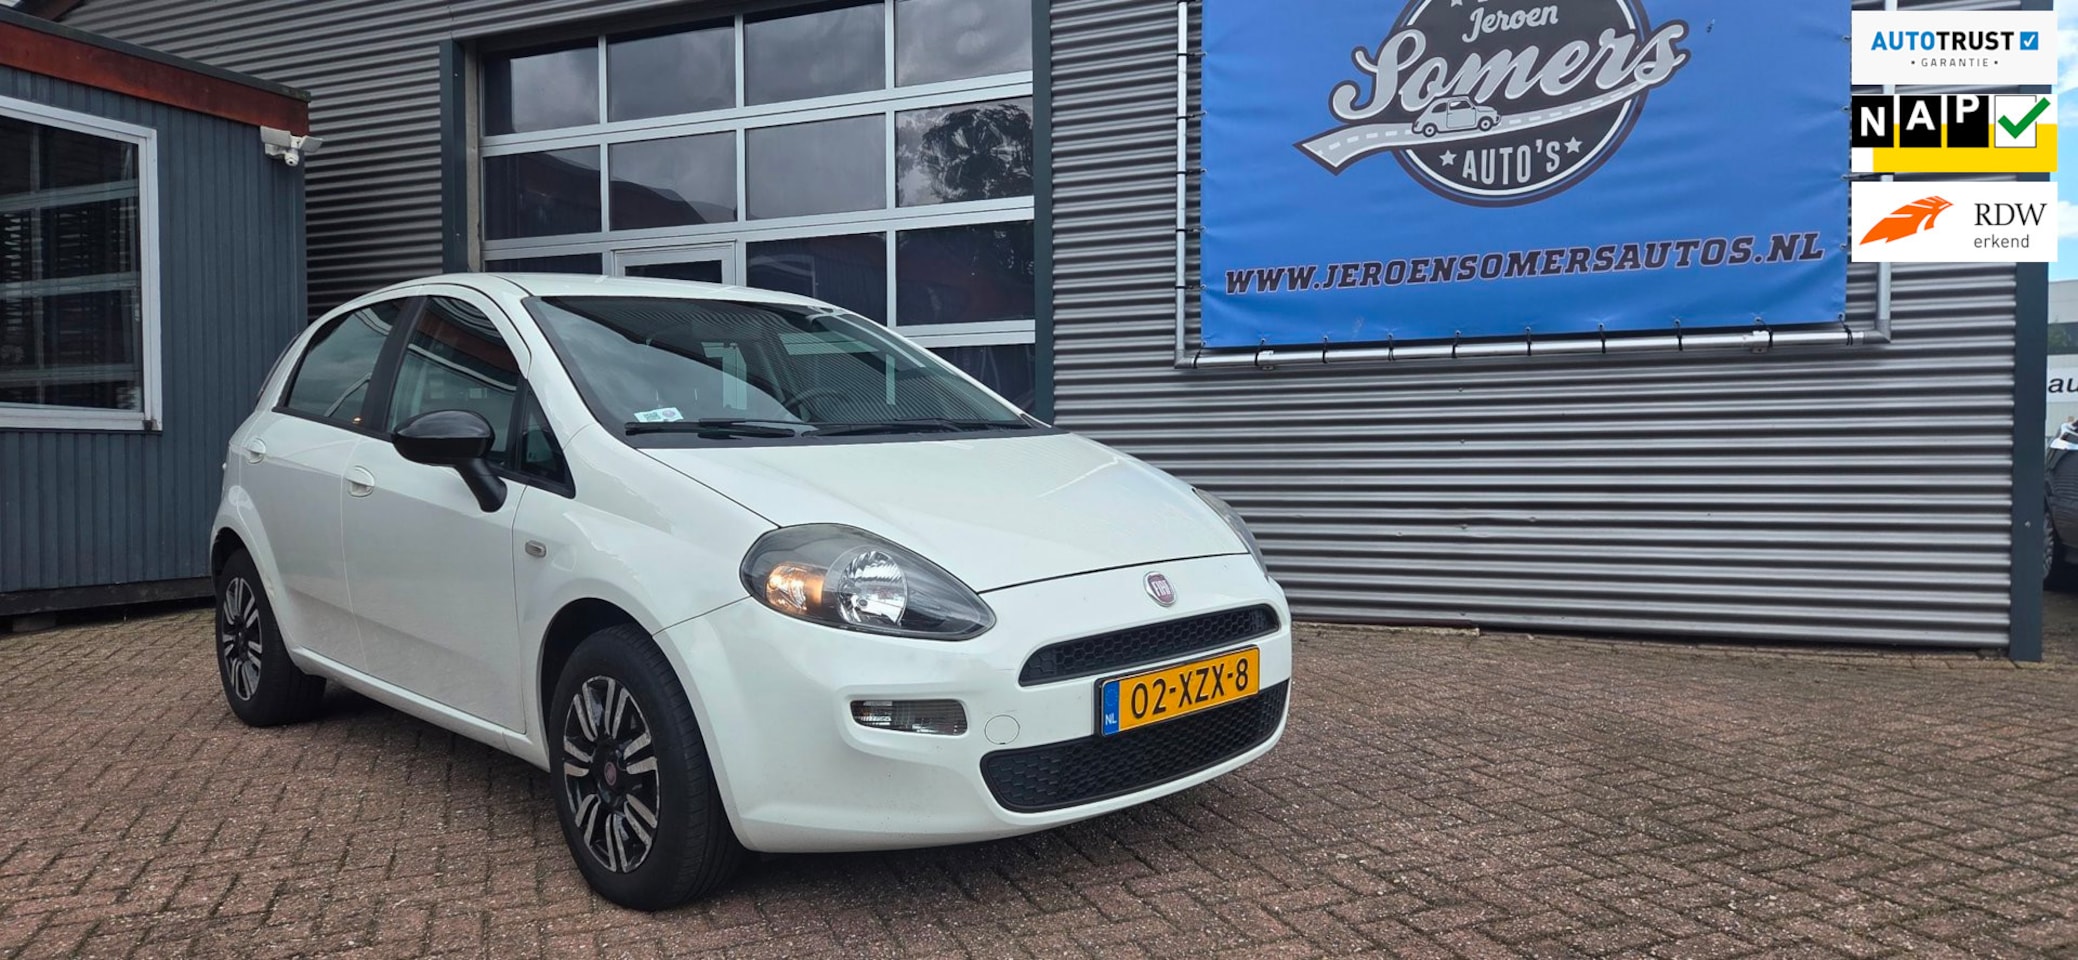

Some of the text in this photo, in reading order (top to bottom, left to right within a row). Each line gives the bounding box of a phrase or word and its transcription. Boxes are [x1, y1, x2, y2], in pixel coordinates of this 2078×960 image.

[1461, 5, 1558, 43] Jeroen
[1332, 24, 1687, 120] Somers
[1462, 139, 1561, 186] AUTO'S
[1225, 232, 1825, 295] WWW.JEROENSOMERSAUTOS.NL
[1131, 658, 1249, 719] 02-XZX-8
[1105, 713, 1117, 724] NL
